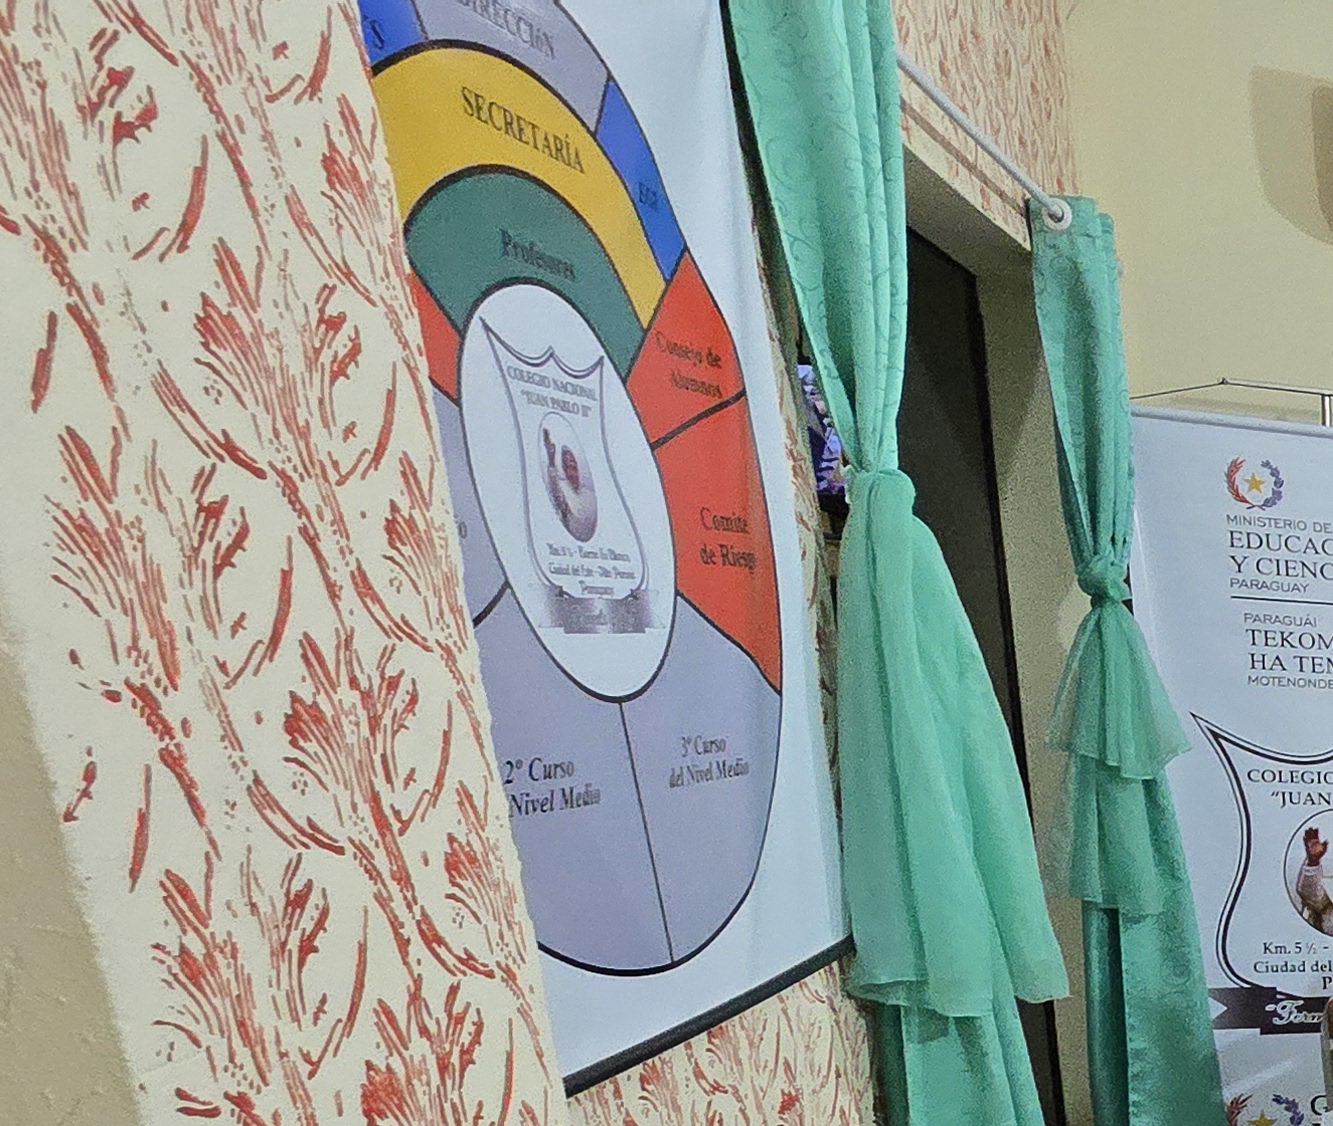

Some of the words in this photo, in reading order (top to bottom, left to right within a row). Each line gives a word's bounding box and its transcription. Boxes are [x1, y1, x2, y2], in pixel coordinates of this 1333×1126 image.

[462, 86, 584, 173] SECRETARÍA
[706, 345, 722, 369] de
[1226, 514, 1307, 531] MINISTERIO
[1313, 522, 1333, 534] DE
[701, 543, 716, 566] de
[1230, 555, 1249, 574] Y
[1229, 577, 1310, 593] PARAGUAY
[1243, 612, 1318, 628] PARAGUÁI
[1248, 653, 1287, 671] HA
[694, 735, 727, 756] Curso
[529, 757, 575, 782] Curso
[669, 765, 685, 788] del
[687, 760, 714, 786] Nivel
[715, 758, 750, 781] Medio
[508, 790, 555, 818] Nivel
[1263, 942, 1291, 954] Km.
[1295, 942, 1302, 954] 5
[1254, 961, 1306, 974] Ciudad
[1311, 960, 1332, 973] del
